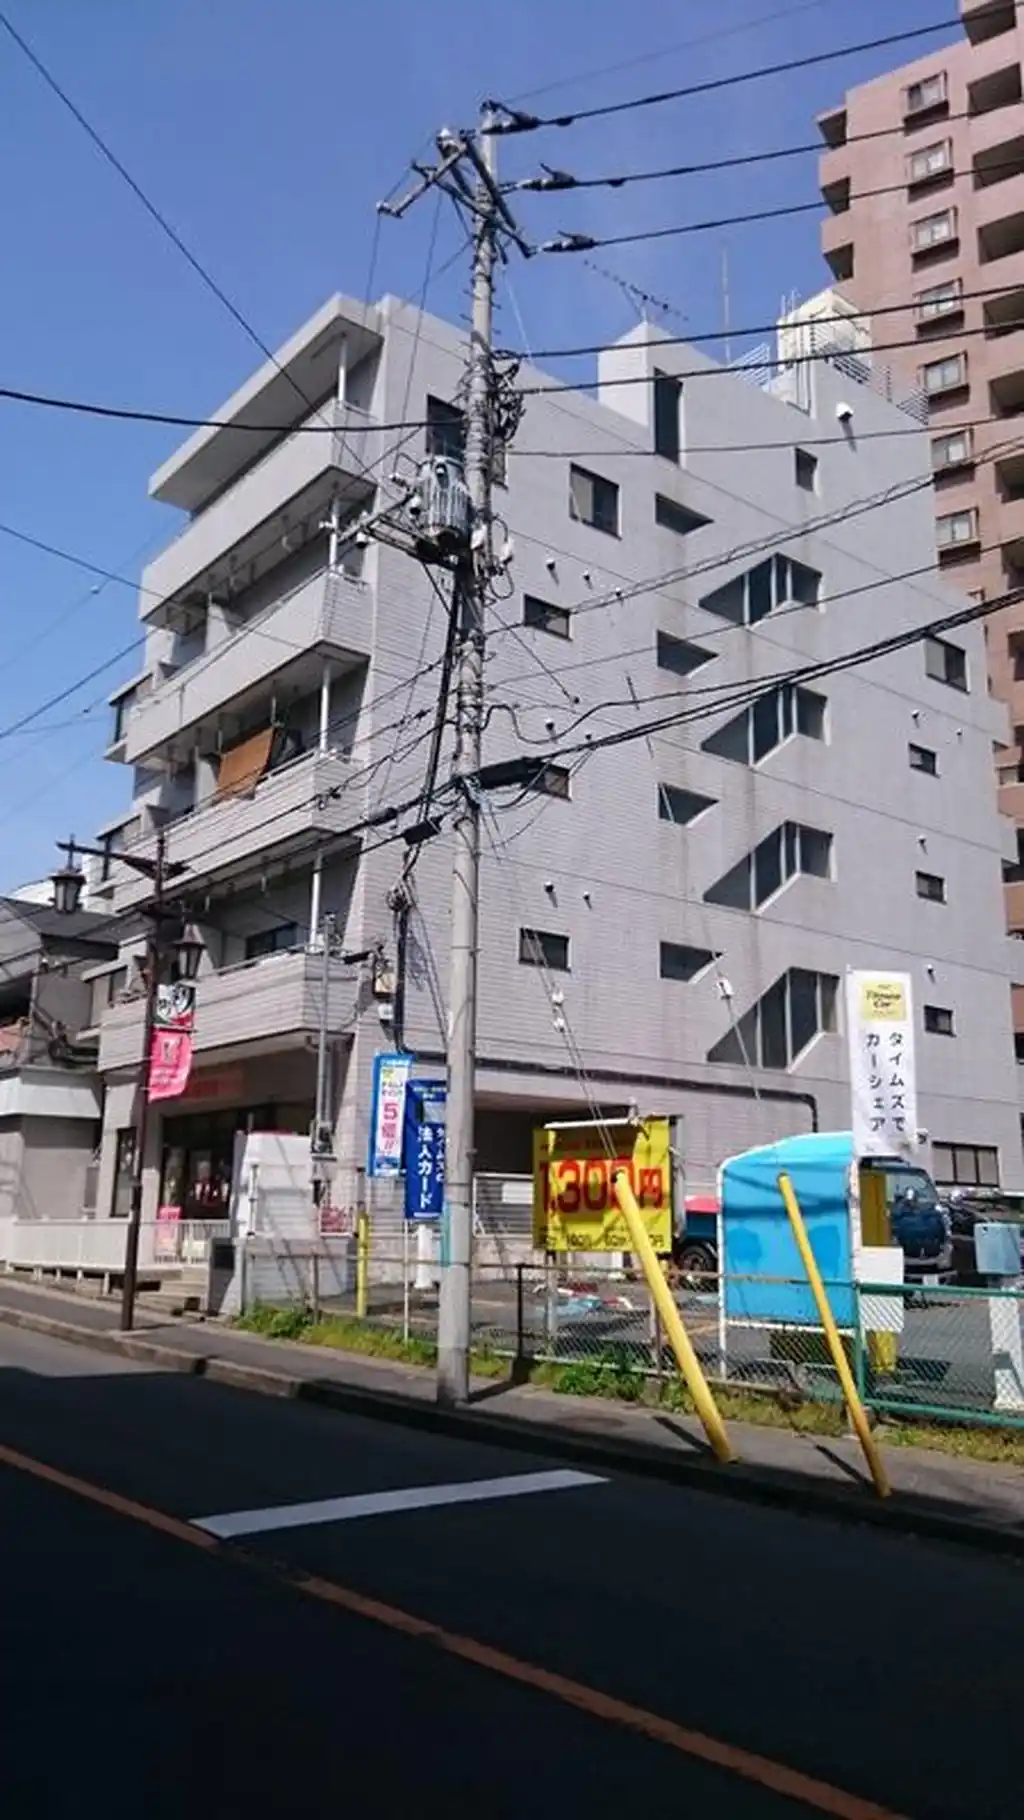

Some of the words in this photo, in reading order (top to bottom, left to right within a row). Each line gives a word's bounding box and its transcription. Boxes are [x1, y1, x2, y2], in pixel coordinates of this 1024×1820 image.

[865, 1032, 886, 1132] カーシェア
[888, 1031, 906, 1132] タイムズで
[417, 1125, 434, 1210] 法人カード
